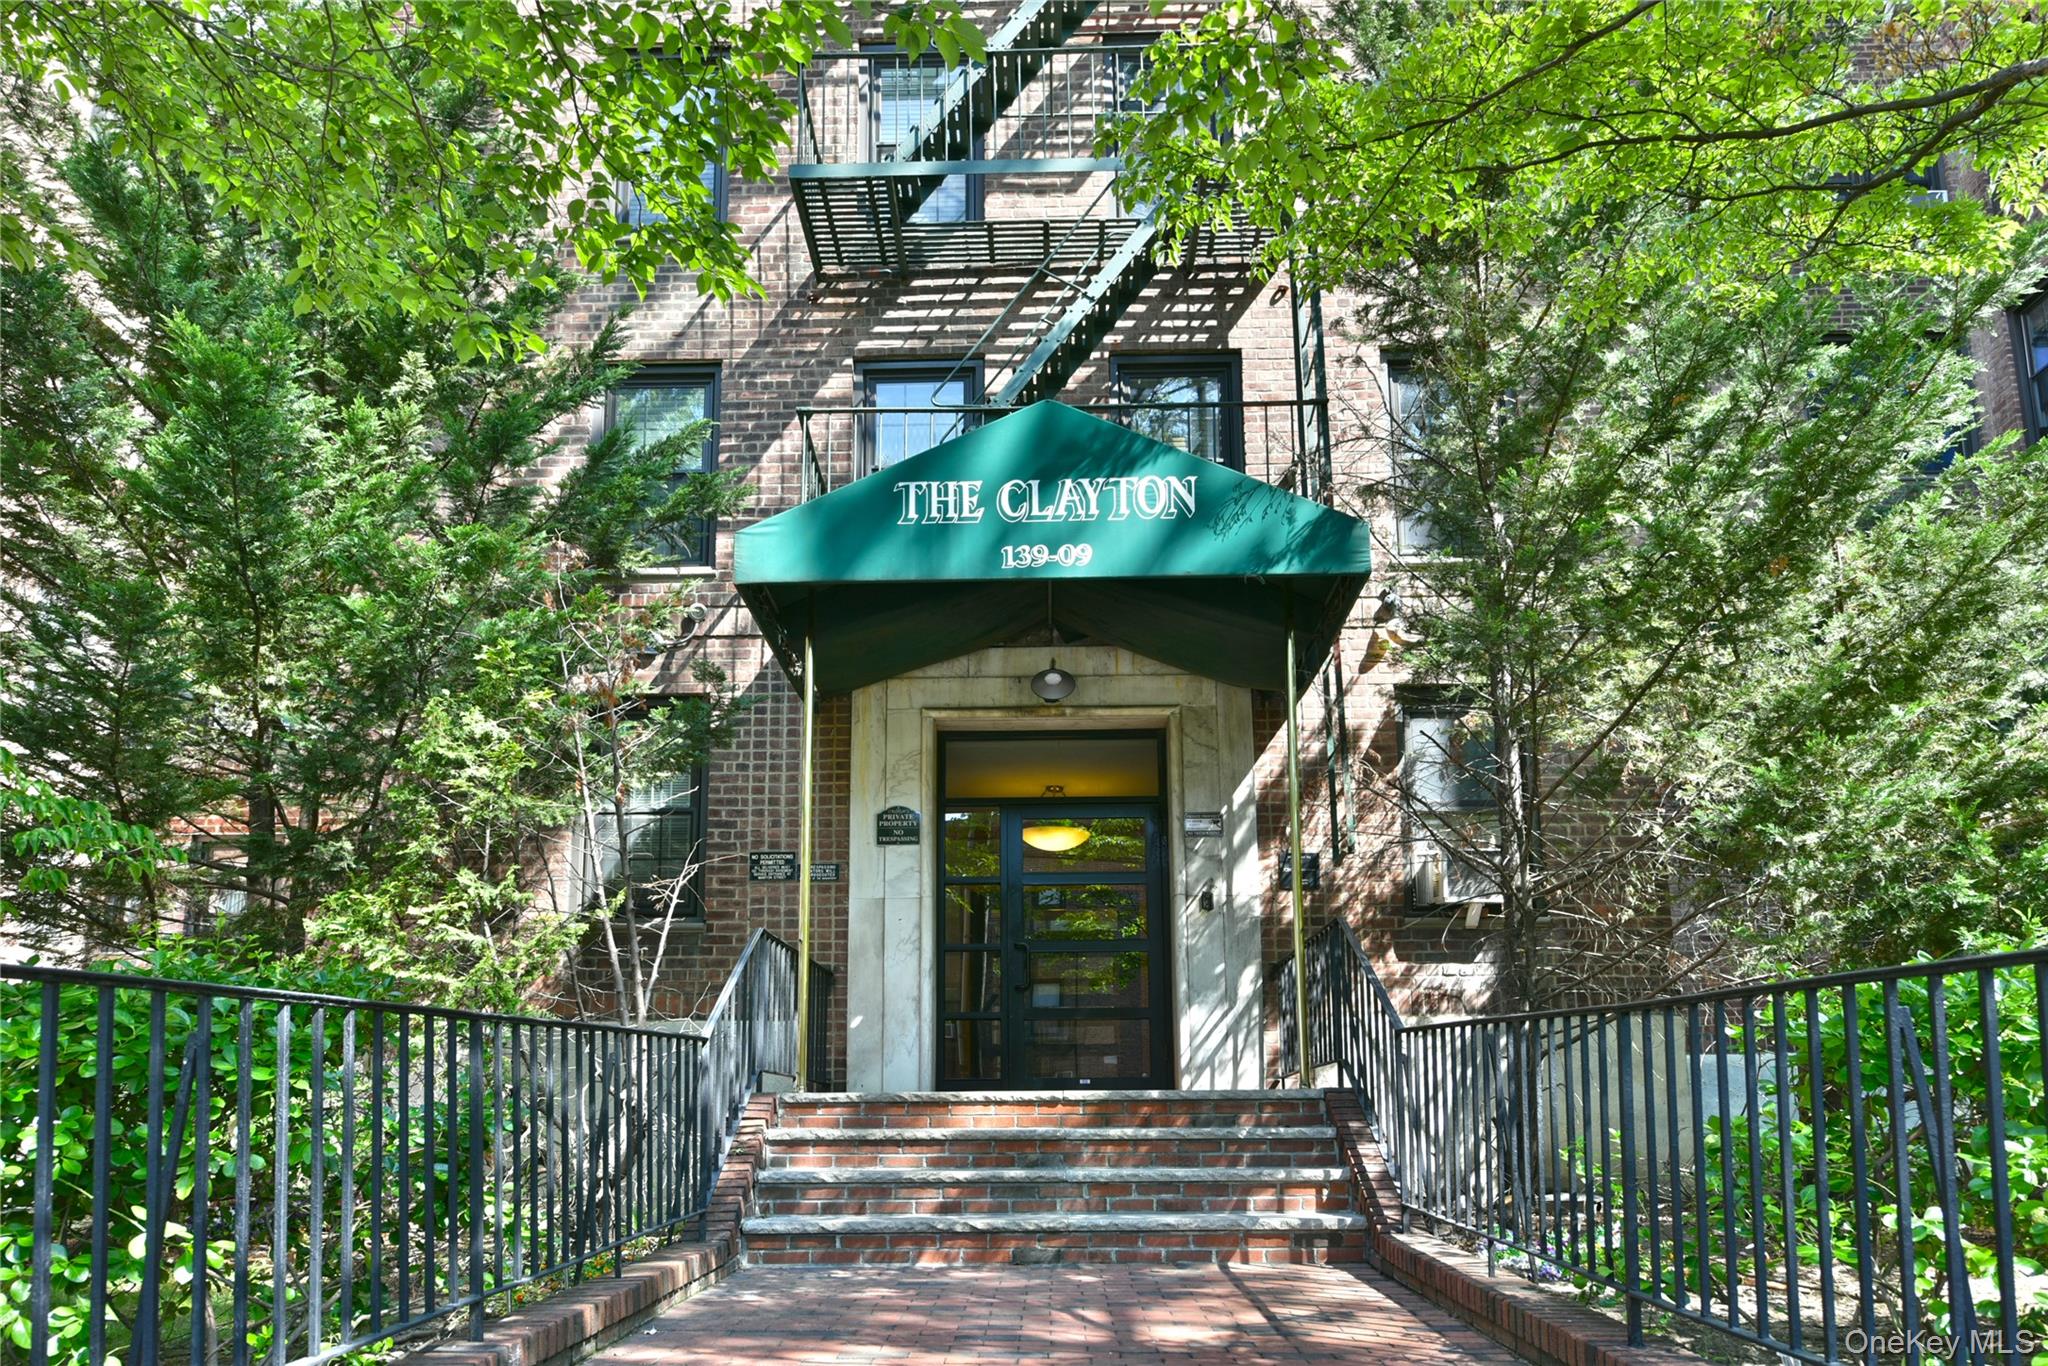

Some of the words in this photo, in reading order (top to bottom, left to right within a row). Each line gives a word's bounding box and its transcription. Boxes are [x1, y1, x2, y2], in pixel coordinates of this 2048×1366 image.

[893, 480, 985, 525] THE
[996, 475, 1199, 523] CLAYTON
[1001, 543, 1093, 569] 139-09
